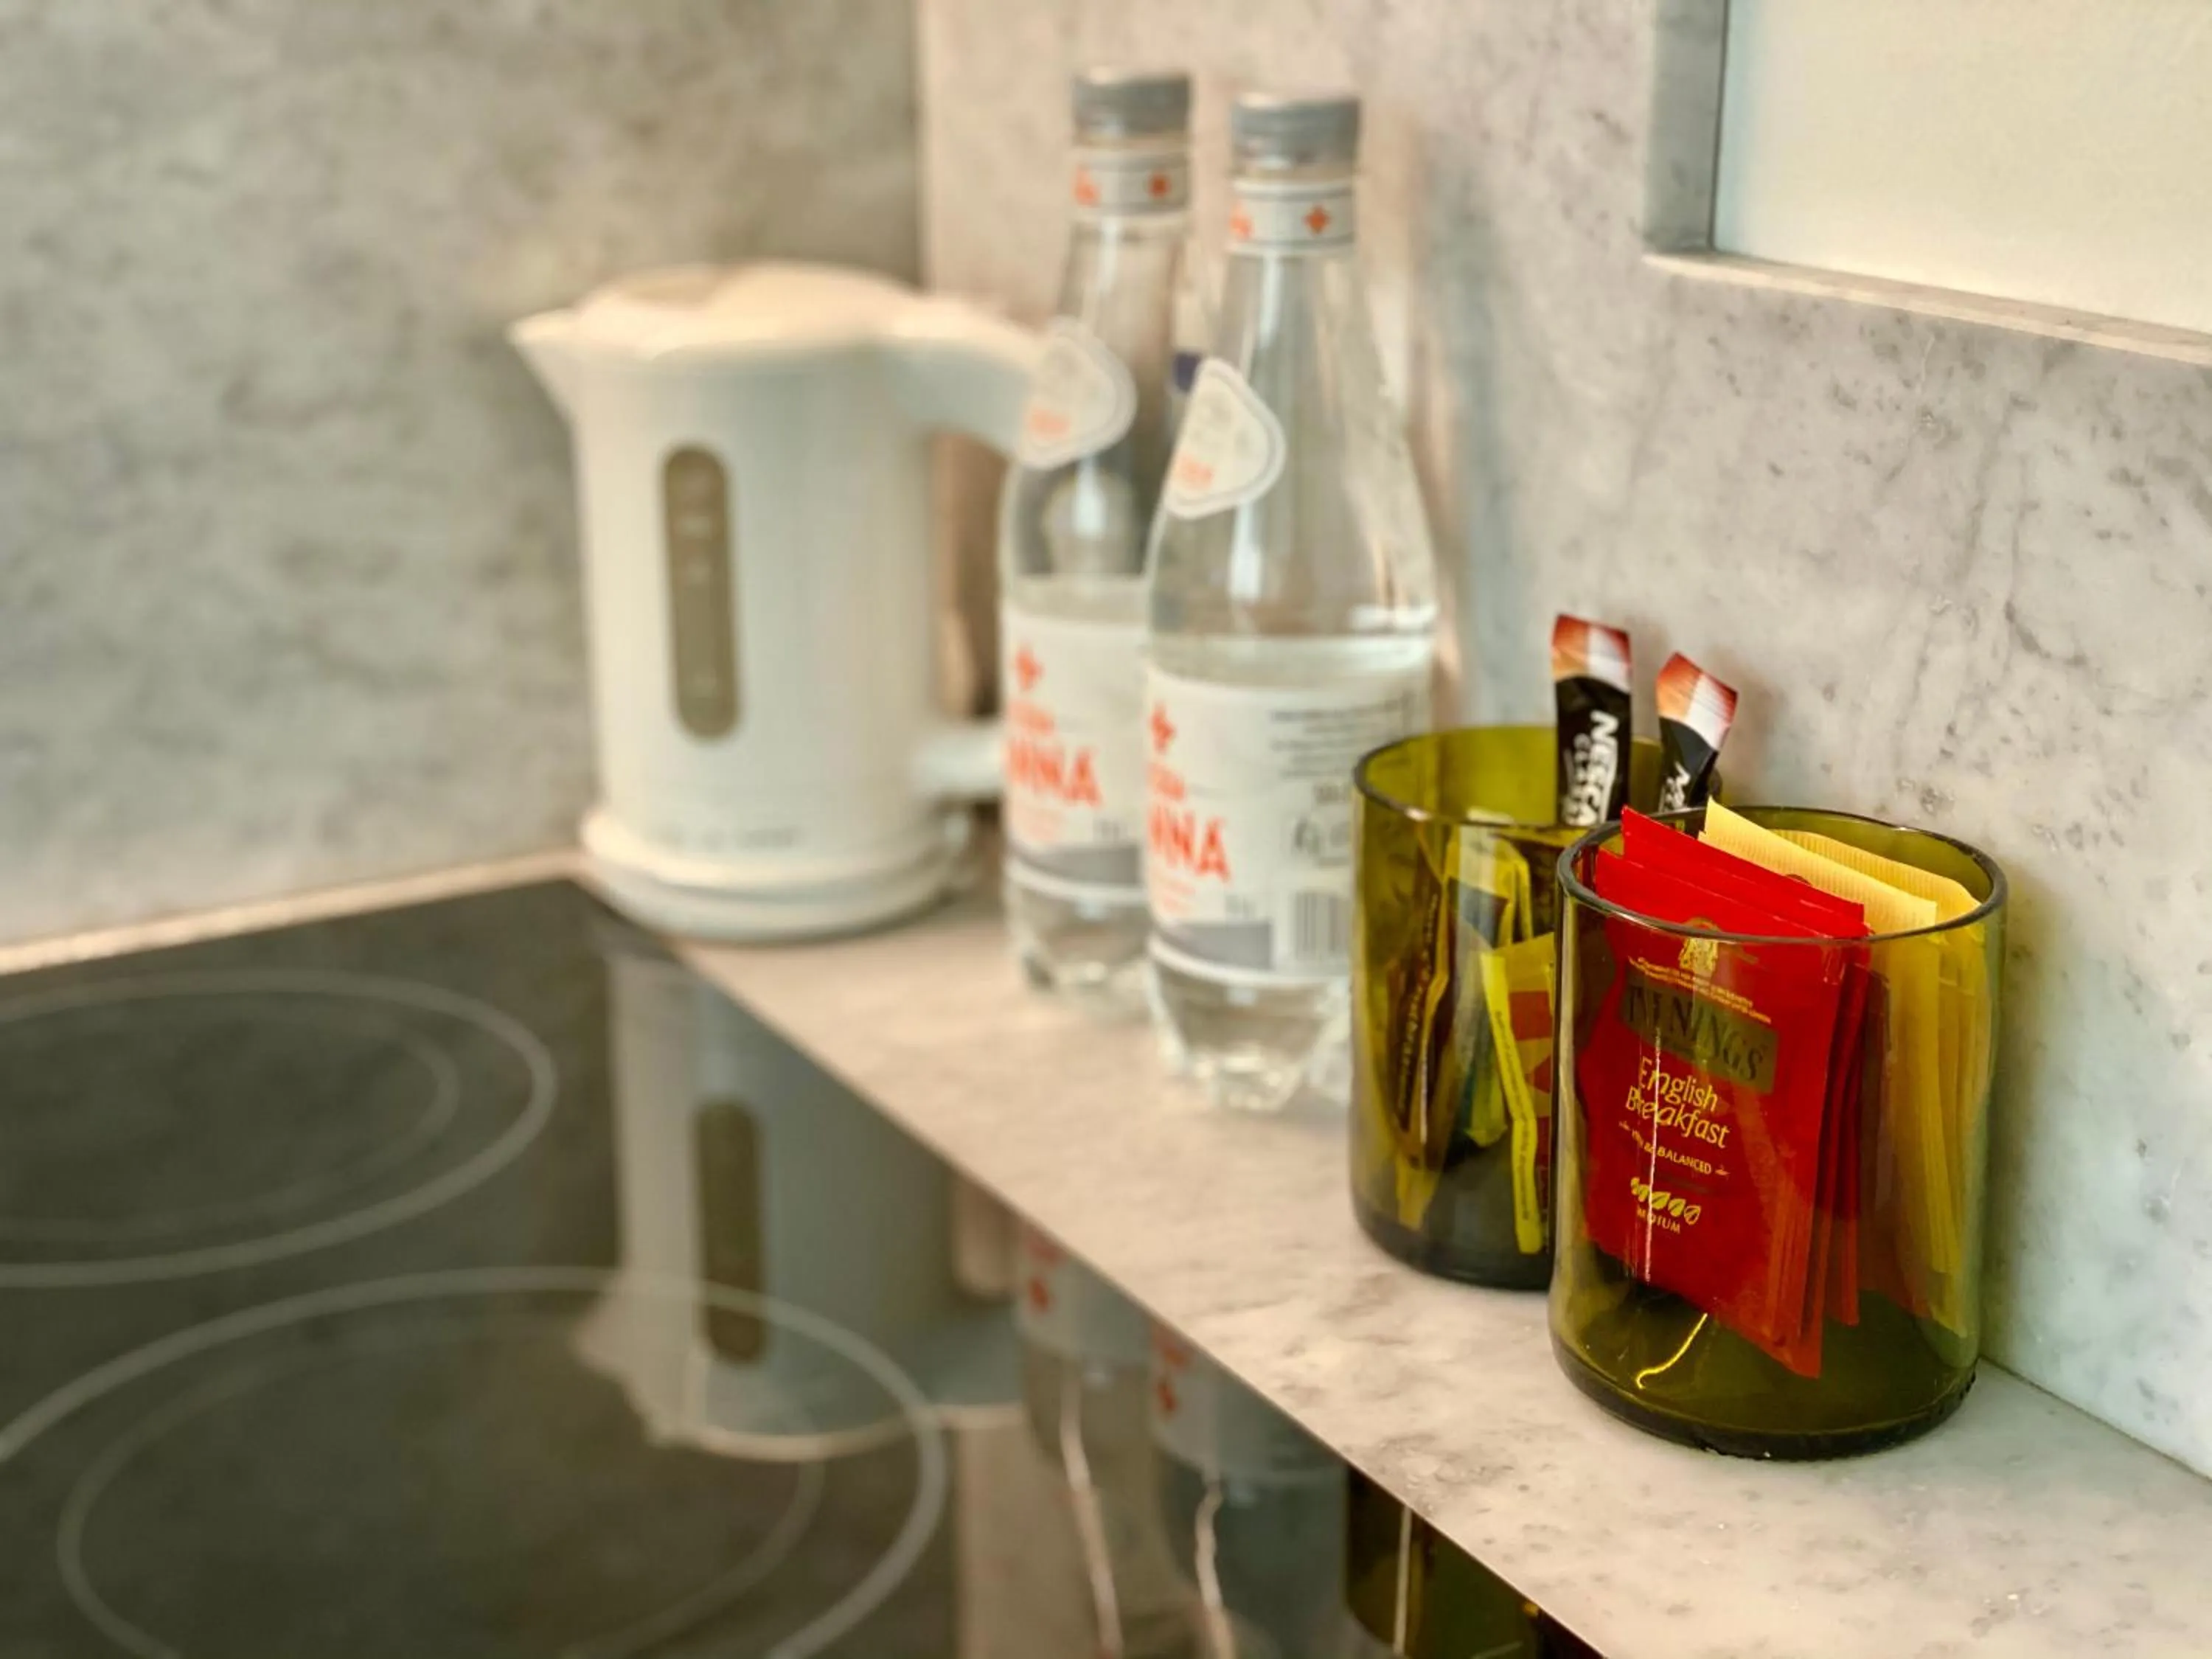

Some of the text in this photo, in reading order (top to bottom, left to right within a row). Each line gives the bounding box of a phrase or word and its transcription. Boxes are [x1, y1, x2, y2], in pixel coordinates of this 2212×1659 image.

[1638, 1056, 1718, 1112] English
[1626, 1086, 1731, 1149] Breakfast
[1657, 1146, 1711, 1175] BALANCED
[1636, 1207, 1680, 1234] MDIUM
